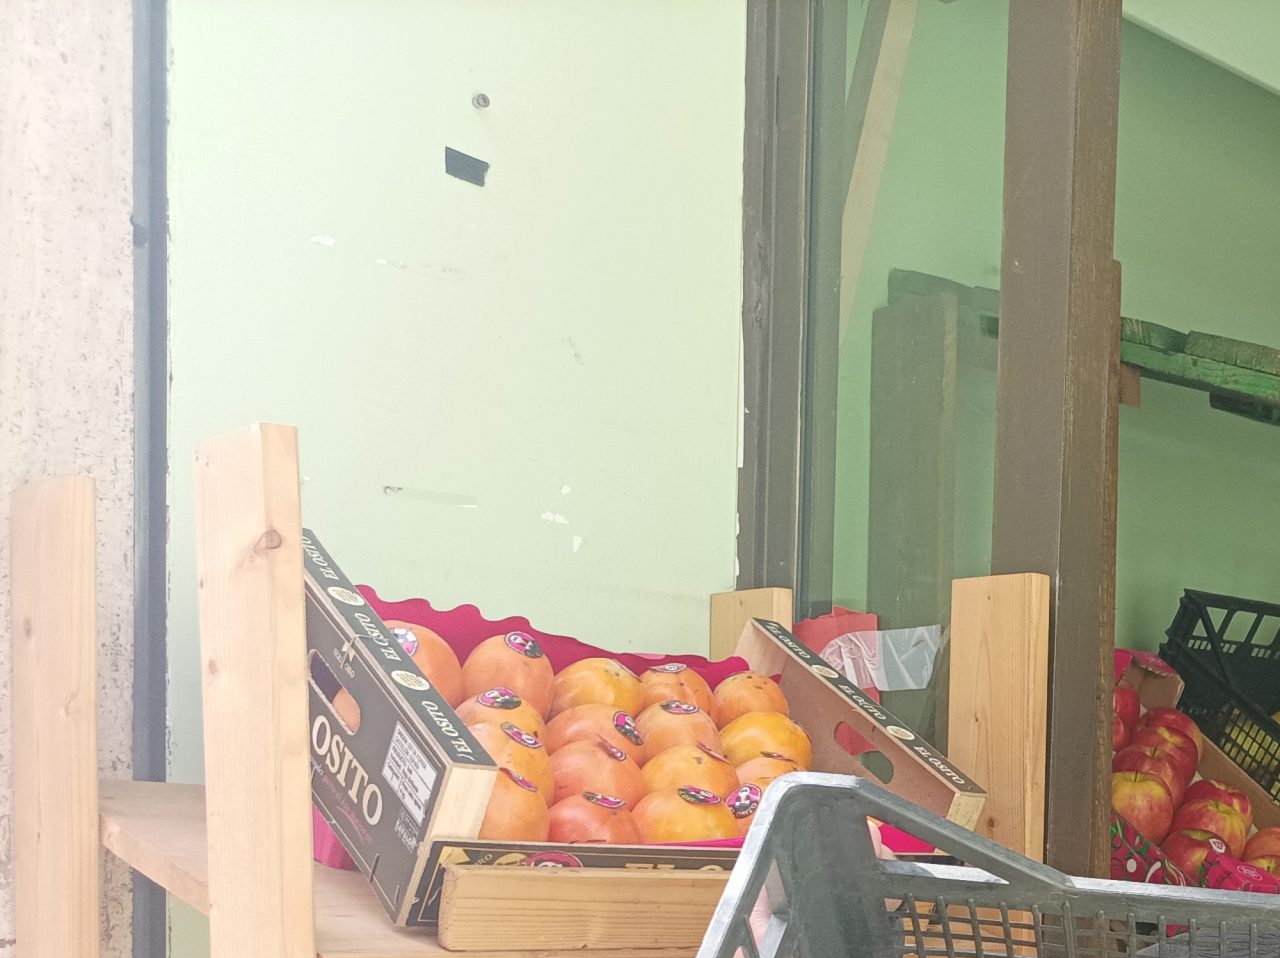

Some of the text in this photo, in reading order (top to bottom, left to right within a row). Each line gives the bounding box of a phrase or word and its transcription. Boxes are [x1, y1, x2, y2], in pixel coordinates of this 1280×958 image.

[320, 566, 340, 581] EL
[354, 612, 402, 662] EL OSITO
[839, 684, 887, 721] EL OSITO
[421, 700, 475, 755] EL OSITO
[312, 715, 383, 826] OSITO
[914, 745, 965, 785] EL OSITO
